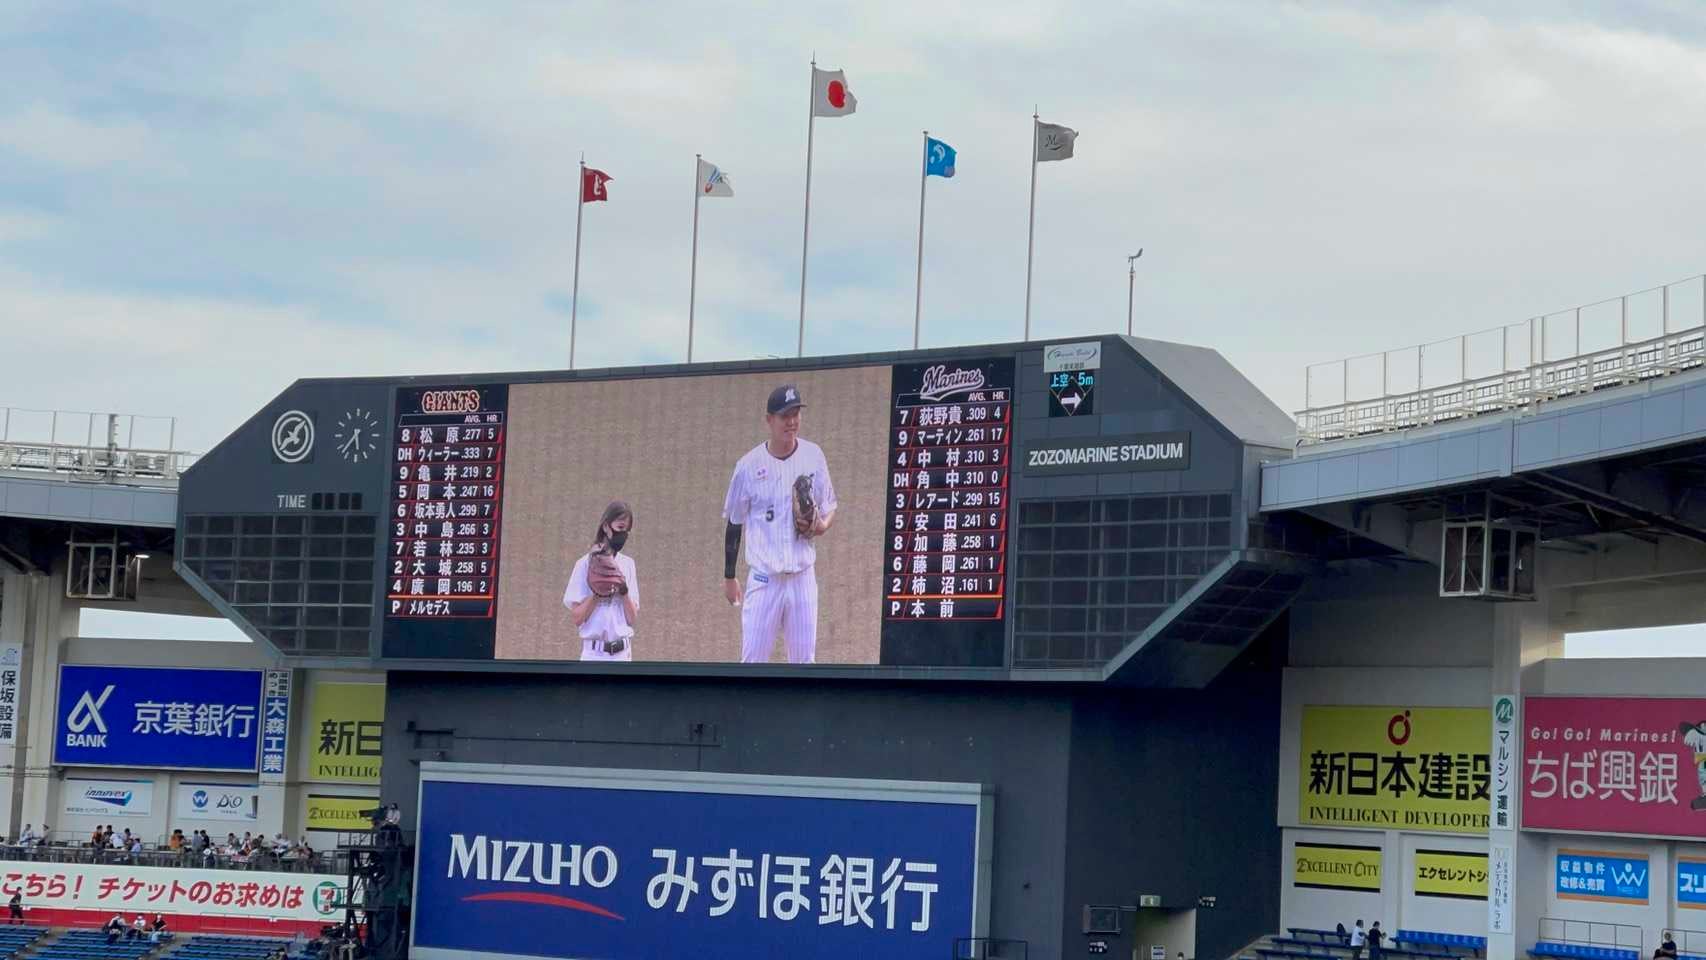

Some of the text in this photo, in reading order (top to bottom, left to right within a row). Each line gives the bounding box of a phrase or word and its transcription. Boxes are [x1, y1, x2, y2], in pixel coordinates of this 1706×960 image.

[920, 365, 984, 398] Marines
[1078, 372, 1094, 385] 5m
[422, 390, 480, 413] GIANTS
[993, 391, 1004, 400] HR
[900, 411, 909, 424] 7
[967, 407, 986, 420] .309
[994, 407, 1001, 418] 4
[402, 429, 410, 442] 8
[463, 429, 481, 440] .277
[488, 428, 494, 439] 5
[899, 428, 1002, 445] 9 マーティン .261 17
[398, 448, 412, 460] DH
[418, 447, 459, 461] ウィーラー
[488, 447, 493, 458] 7
[898, 452, 907, 466] 4
[964, 450, 984, 463] .310
[993, 450, 999, 461] 3
[1028, 442, 1183, 466] ZOZOMARINE STADIUM
[400, 467, 408, 479] 9
[461, 466, 479, 478] .219
[486, 467, 492, 477] 2
[894, 473, 908, 487] DH
[964, 472, 983, 484] .310
[992, 471, 998, 483] 0
[399, 485, 407, 497] 5
[460, 486, 478, 497] .247
[483, 486, 493, 496] 16
[277, 494, 307, 508] TIME
[896, 490, 1000, 509] 3 レアード .299 15
[398, 504, 406, 516] 6
[415, 503, 455, 518] 坂本勇人
[484, 505, 489, 515] 7
[396, 523, 404, 535] 3
[483, 524, 488, 534] 3
[896, 515, 903, 529] 5
[962, 515, 981, 527] .241
[990, 514, 996, 526] 6
[396, 542, 404, 554] 7
[482, 543, 487, 553] 3
[894, 536, 903, 550] 8
[990, 536, 994, 547] 1
[394, 561, 402, 573] 2
[481, 562, 486, 573] 5
[894, 557, 902, 571] 6
[989, 557, 993, 569] 1
[393, 580, 401, 592] 4
[480, 581, 485, 592] 2
[893, 578, 901, 592] 2
[959, 578, 978, 591] .161
[988, 579, 993, 590] 1
[392, 600, 449, 615] P メルセデス
[892, 602, 900, 615] P
[132, 701, 255, 738] 京葉銀行
[66, 734, 107, 748] BANK
[263, 699, 286, 772] 大森工業
[318, 719, 384, 756] 新日
[1531, 727, 1677, 743] Go! Go! Marines!
[318, 765, 382, 778] INTELLIG
[1309, 750, 1491, 800] 新日本建設
[1527, 749, 1678, 805] ちば興銀
[1310, 806, 1490, 828] INTELLIGENT DEVELOPER
[1419, 866, 1489, 883] エクセレントシ
[447, 834, 939, 932] MIZUHO みずほ銀行
[0, 873, 305, 909] こちら！ チケットのお求めは
